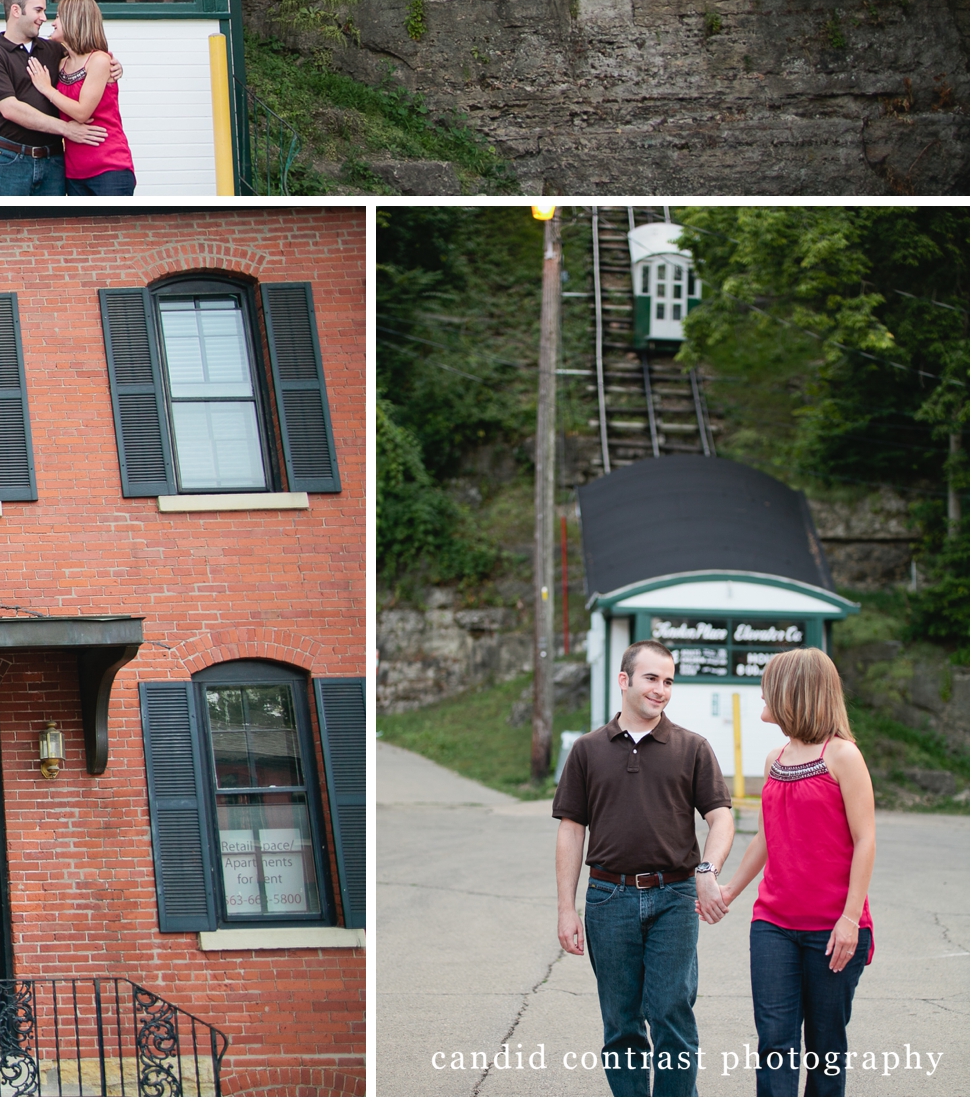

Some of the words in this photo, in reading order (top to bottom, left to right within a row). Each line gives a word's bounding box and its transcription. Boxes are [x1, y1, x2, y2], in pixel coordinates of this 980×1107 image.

[221, 840, 253, 852] Retail
[260, 839, 294, 852] pace/
[237, 873, 253, 885] for
[257, 874, 283, 884] ent
